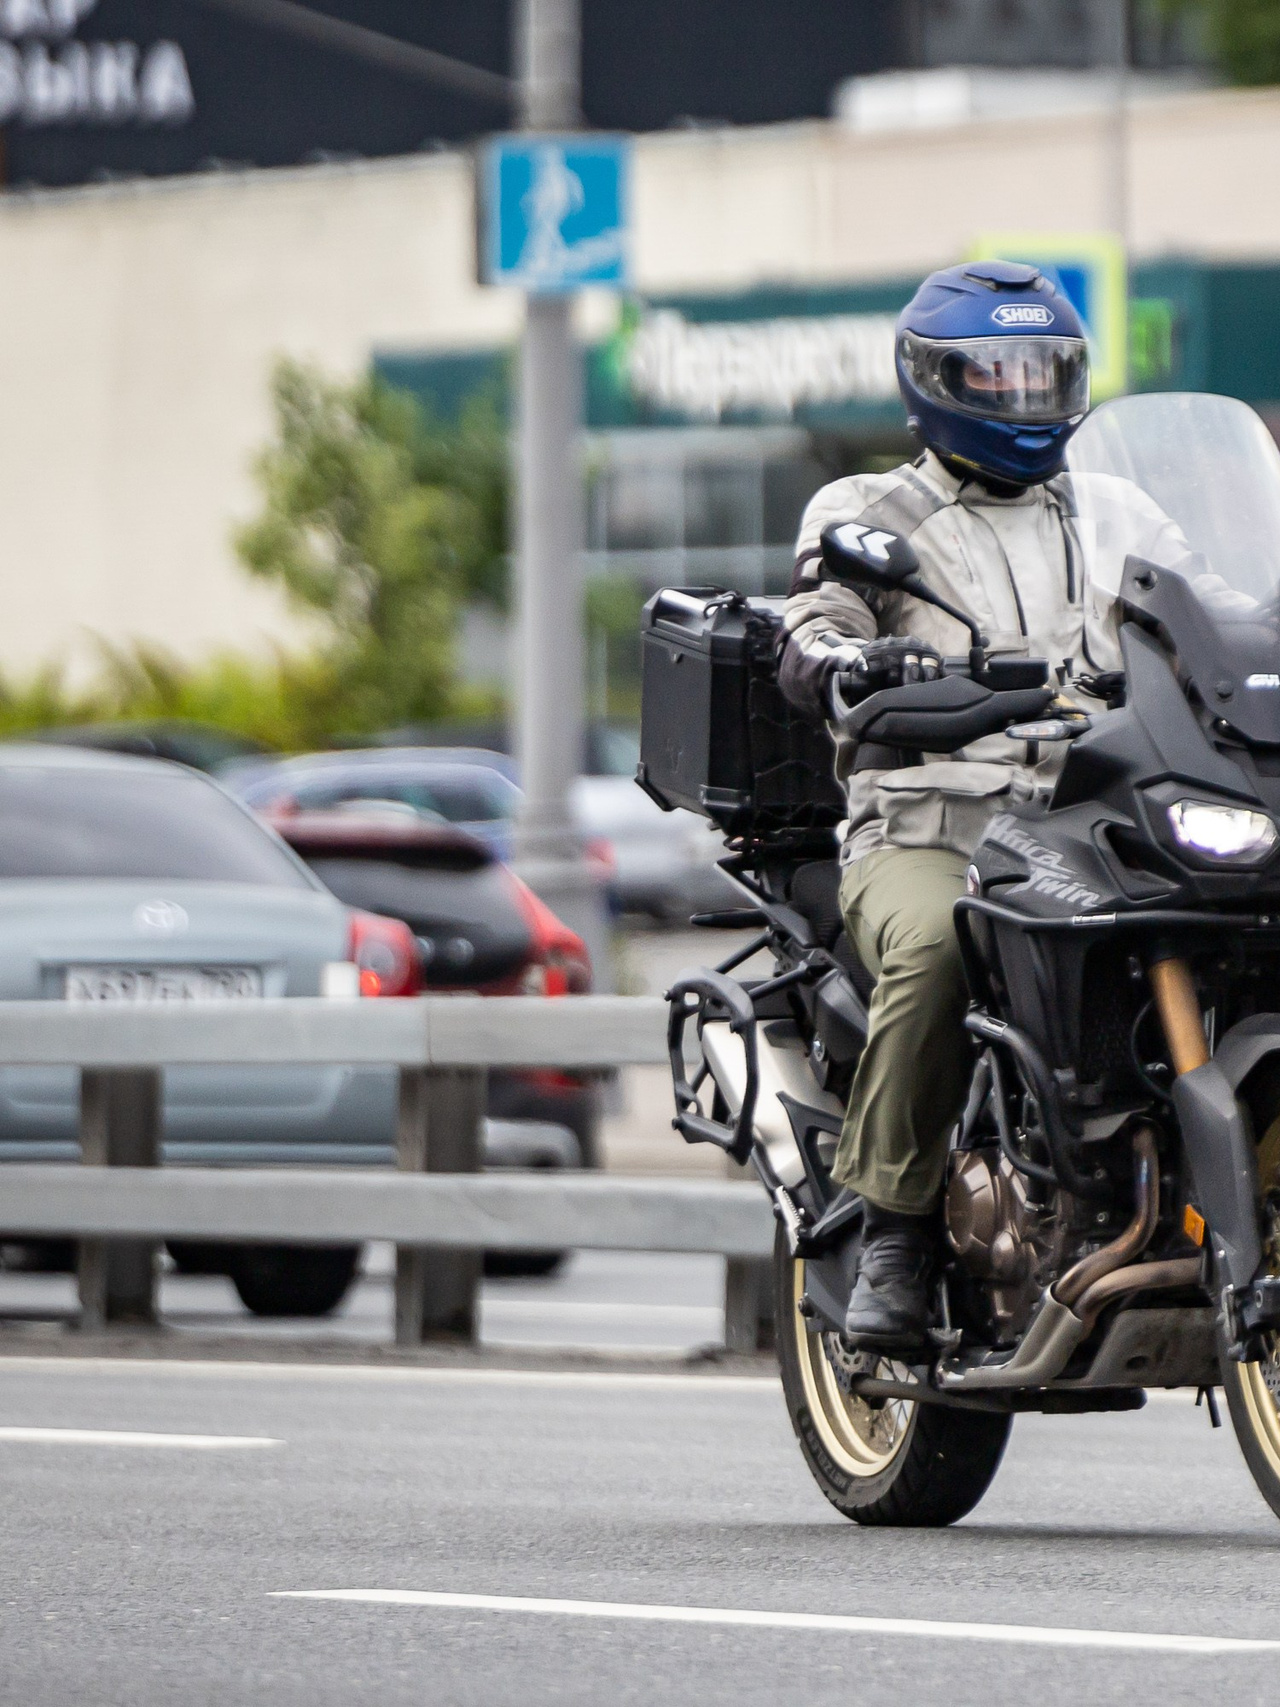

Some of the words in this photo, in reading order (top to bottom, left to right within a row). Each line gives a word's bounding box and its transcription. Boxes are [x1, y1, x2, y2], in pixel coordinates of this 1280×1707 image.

[1000, 308, 1048, 322] SHOEI
[978, 812, 1078, 874] Africa
[1004, 863, 1101, 907] Twin
